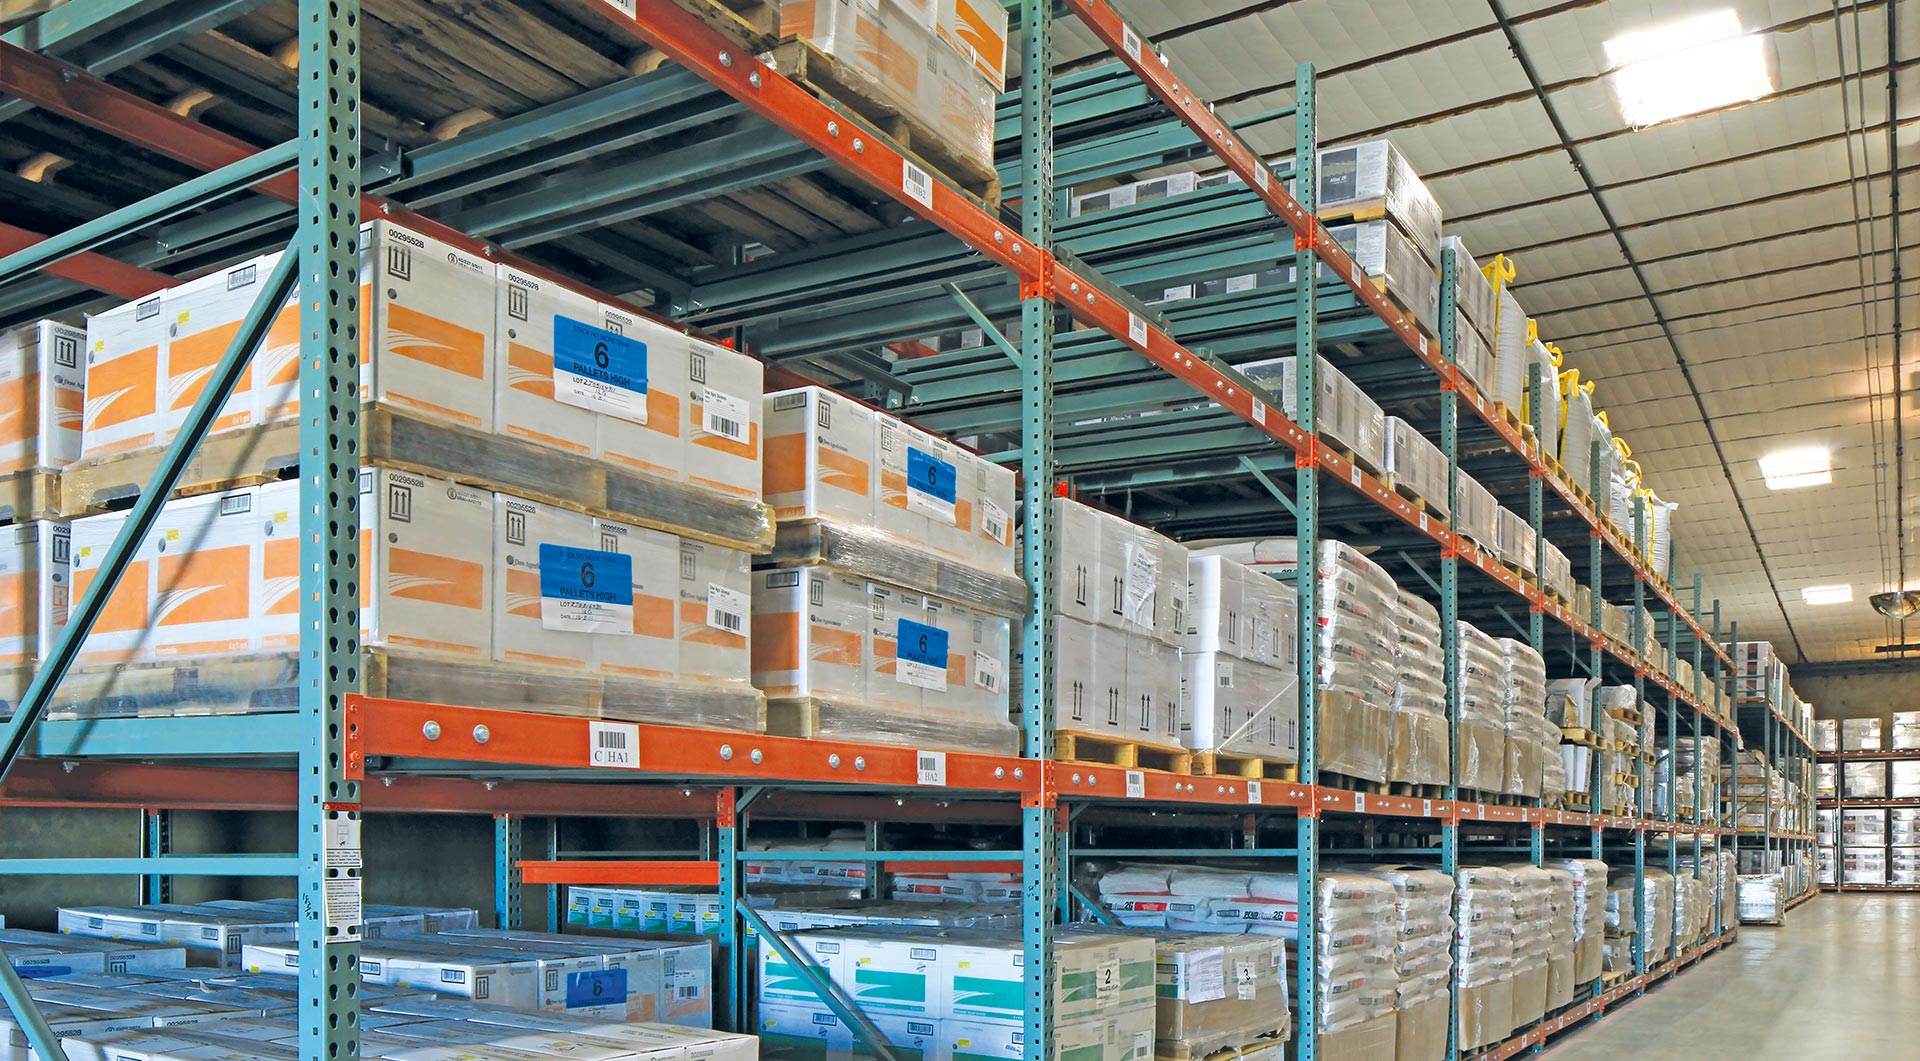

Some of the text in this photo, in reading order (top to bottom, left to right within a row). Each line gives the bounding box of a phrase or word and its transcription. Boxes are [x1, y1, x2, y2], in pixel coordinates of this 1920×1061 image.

[388, 228, 425, 248] 00295528
[508, 273, 539, 291] 00295528
[594, 342, 609, 369] 6
[573, 362, 609, 381] PALLETS
[610, 374, 631, 387] HIGH
[389, 474, 424, 488] 00295528
[928, 466, 936, 486] 6
[581, 562, 594, 588] 6
[560, 588, 616, 601] PALLETS HIGH
[919, 634, 928, 654] 6
[594, 750, 628, 763] C HA1
[1105, 968, 1112, 985] 2
[593, 979, 603, 997] 6
